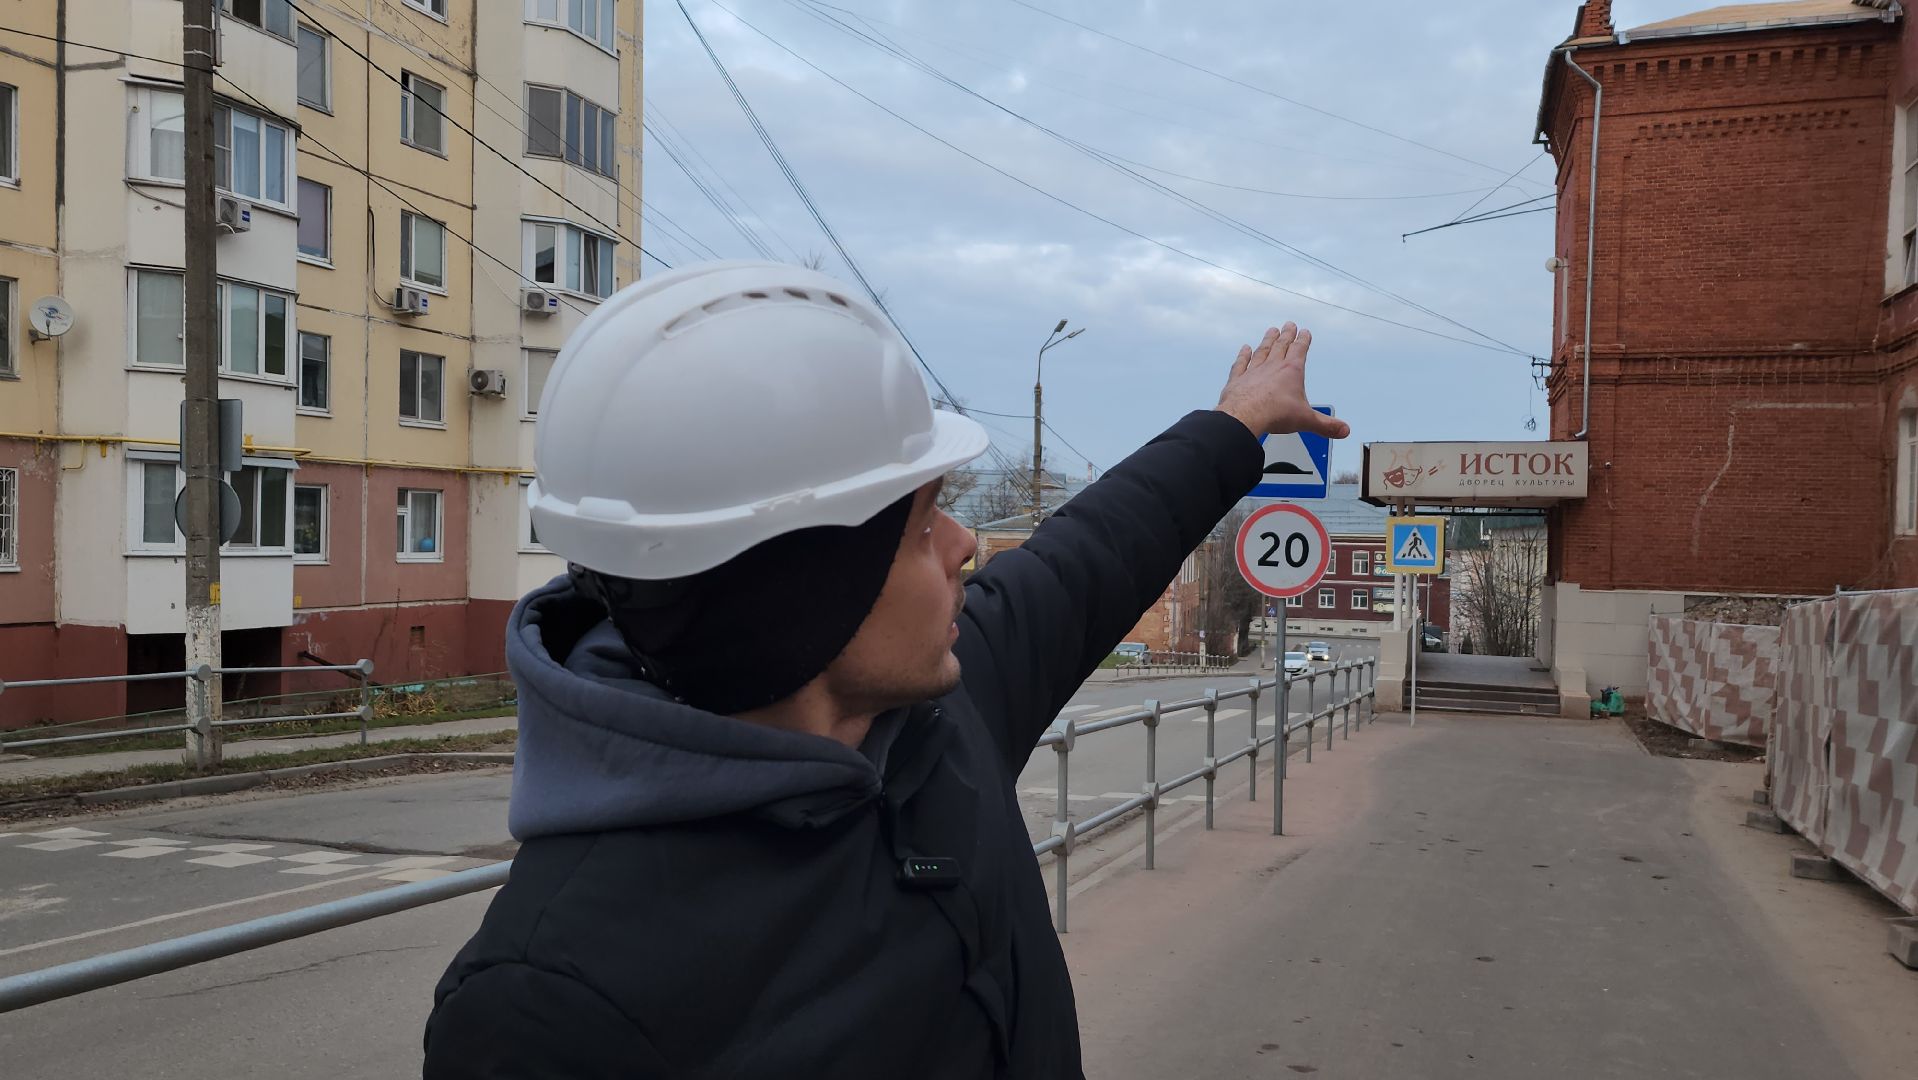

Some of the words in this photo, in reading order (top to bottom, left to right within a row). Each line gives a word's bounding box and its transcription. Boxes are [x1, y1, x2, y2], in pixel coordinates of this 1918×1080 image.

[1459, 453, 1574, 475] ИСТОК
[1458, 479, 1504, 487] ДВОРЕЦ
[1515, 479, 1575, 487] КУЛЬТУРЫ
[1258, 532, 1309, 568] 20
